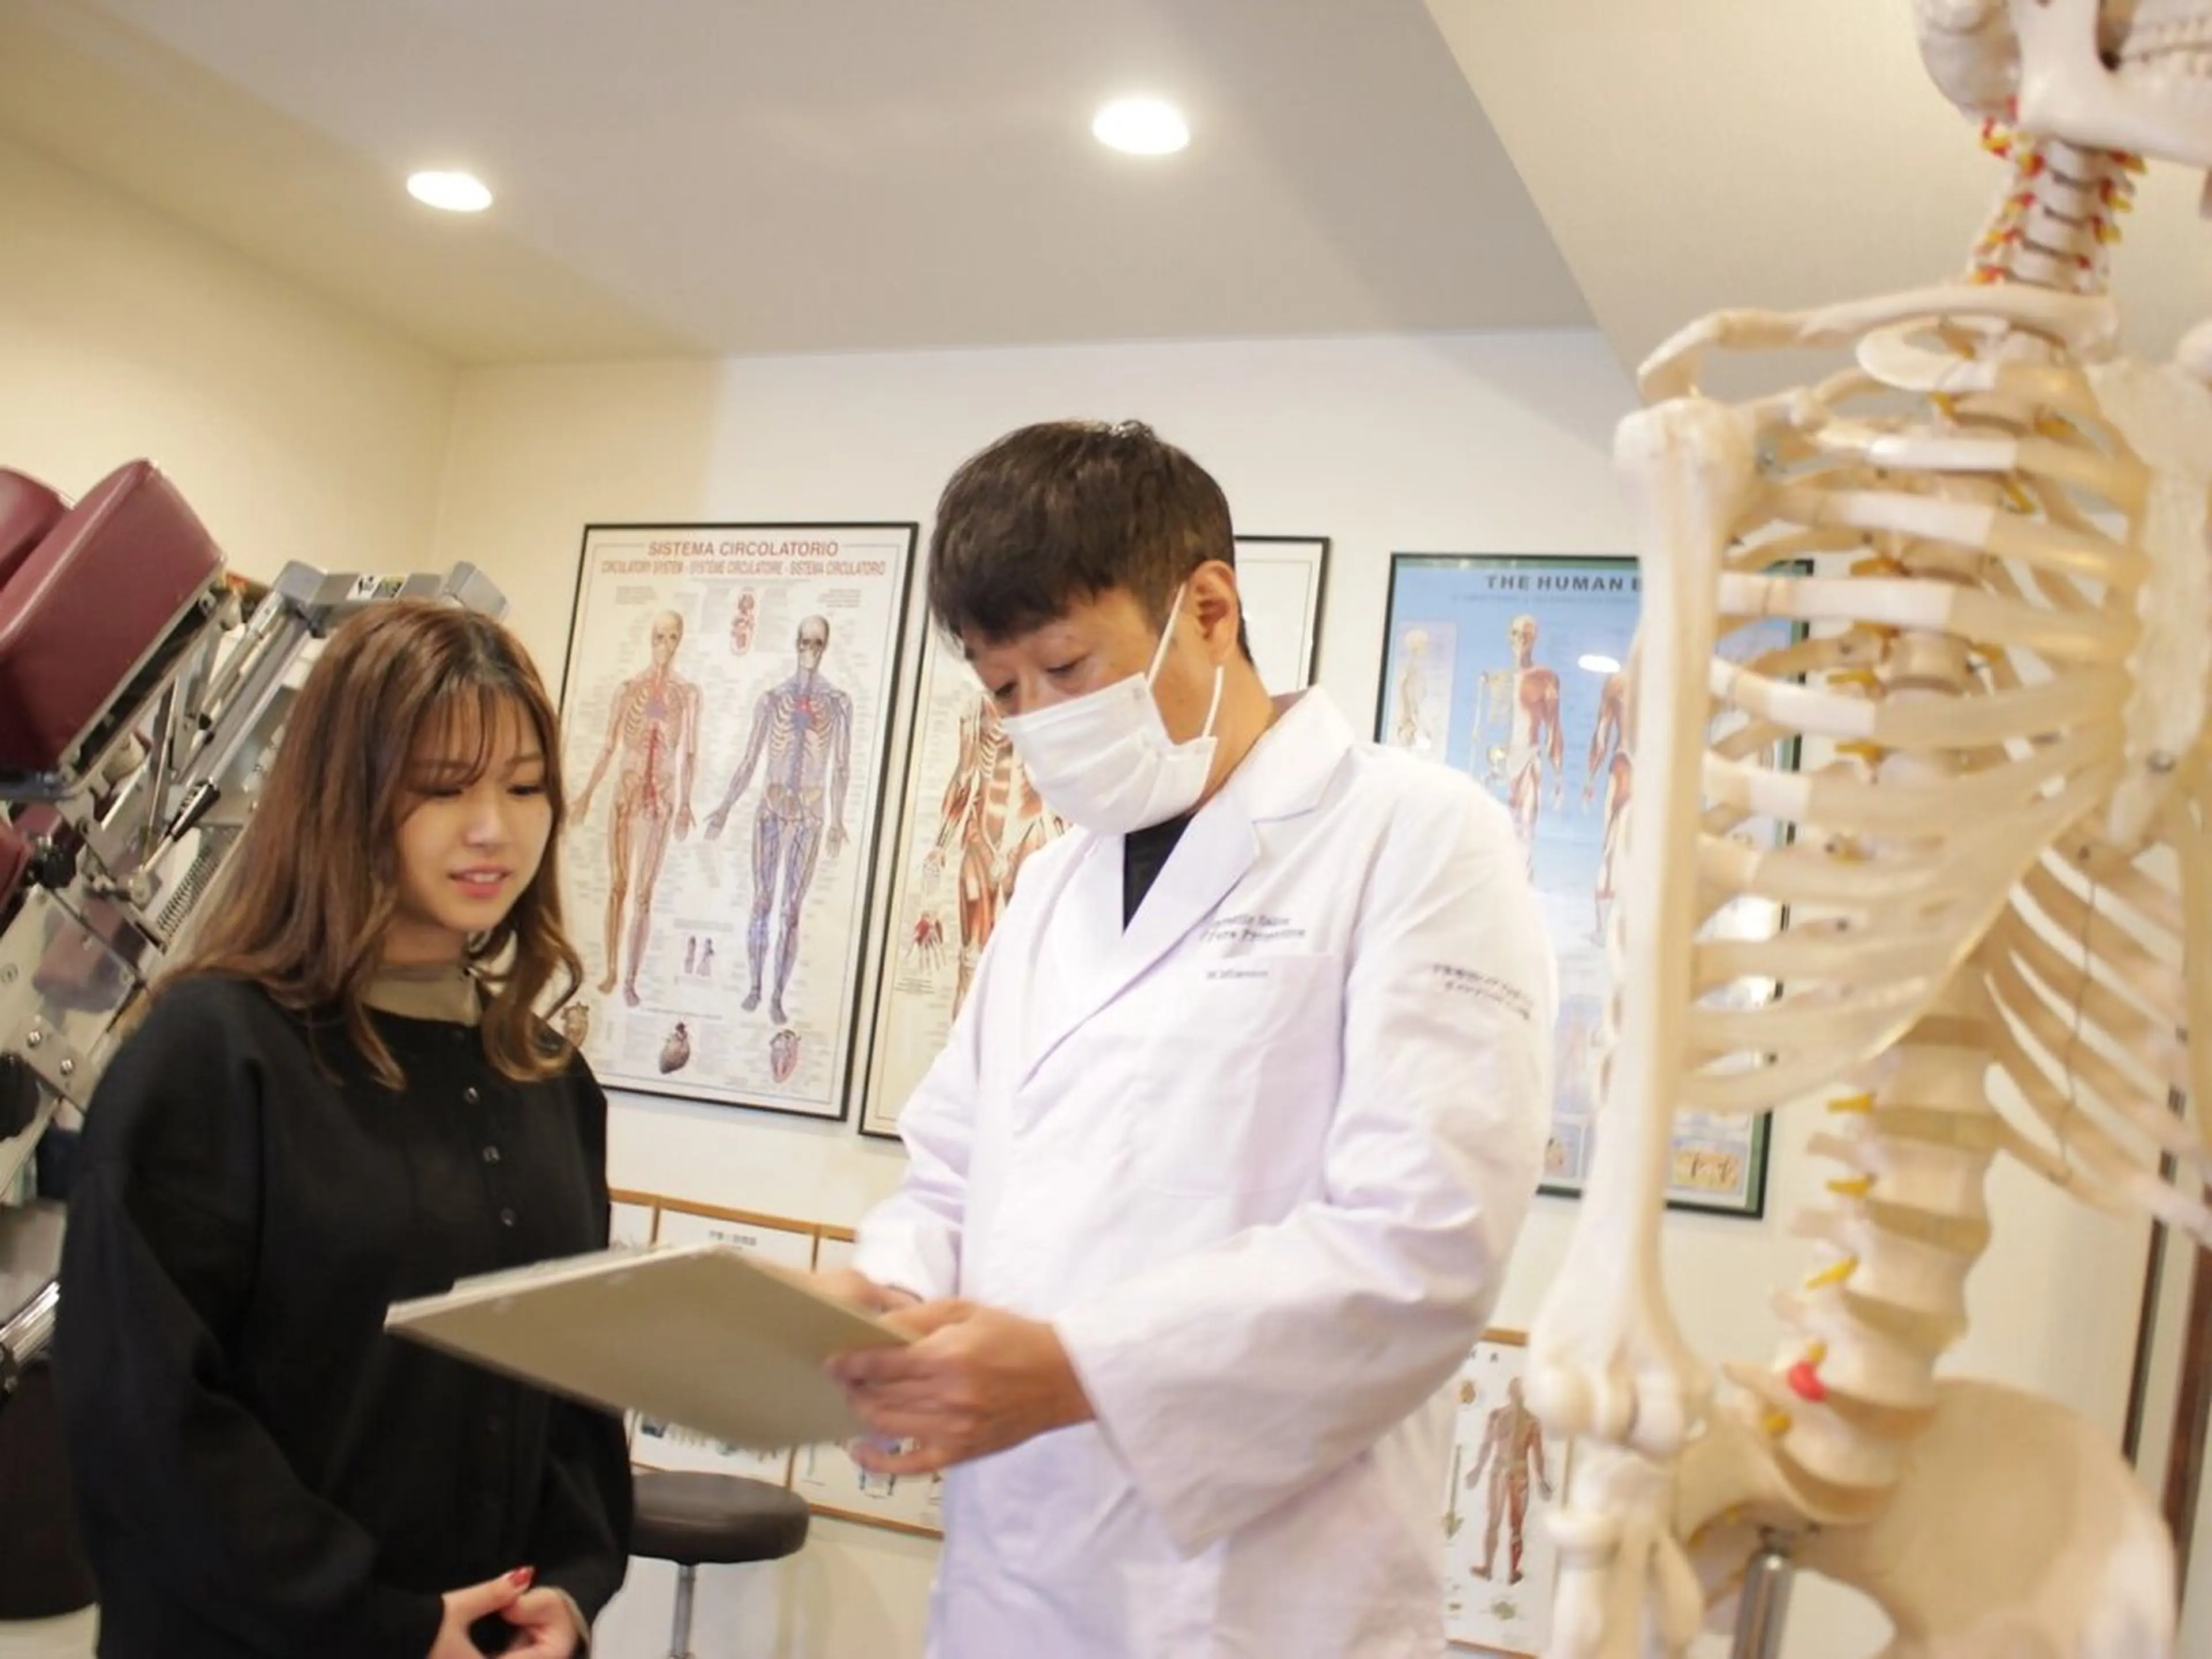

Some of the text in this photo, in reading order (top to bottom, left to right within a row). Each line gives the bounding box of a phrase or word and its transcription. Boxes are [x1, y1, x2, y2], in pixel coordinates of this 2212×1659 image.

[647, 541, 838, 557] SISTEMA CIRCOLATORIO
[1485, 575, 1530, 590] THE
[1537, 575, 1623, 592] HUMAN
